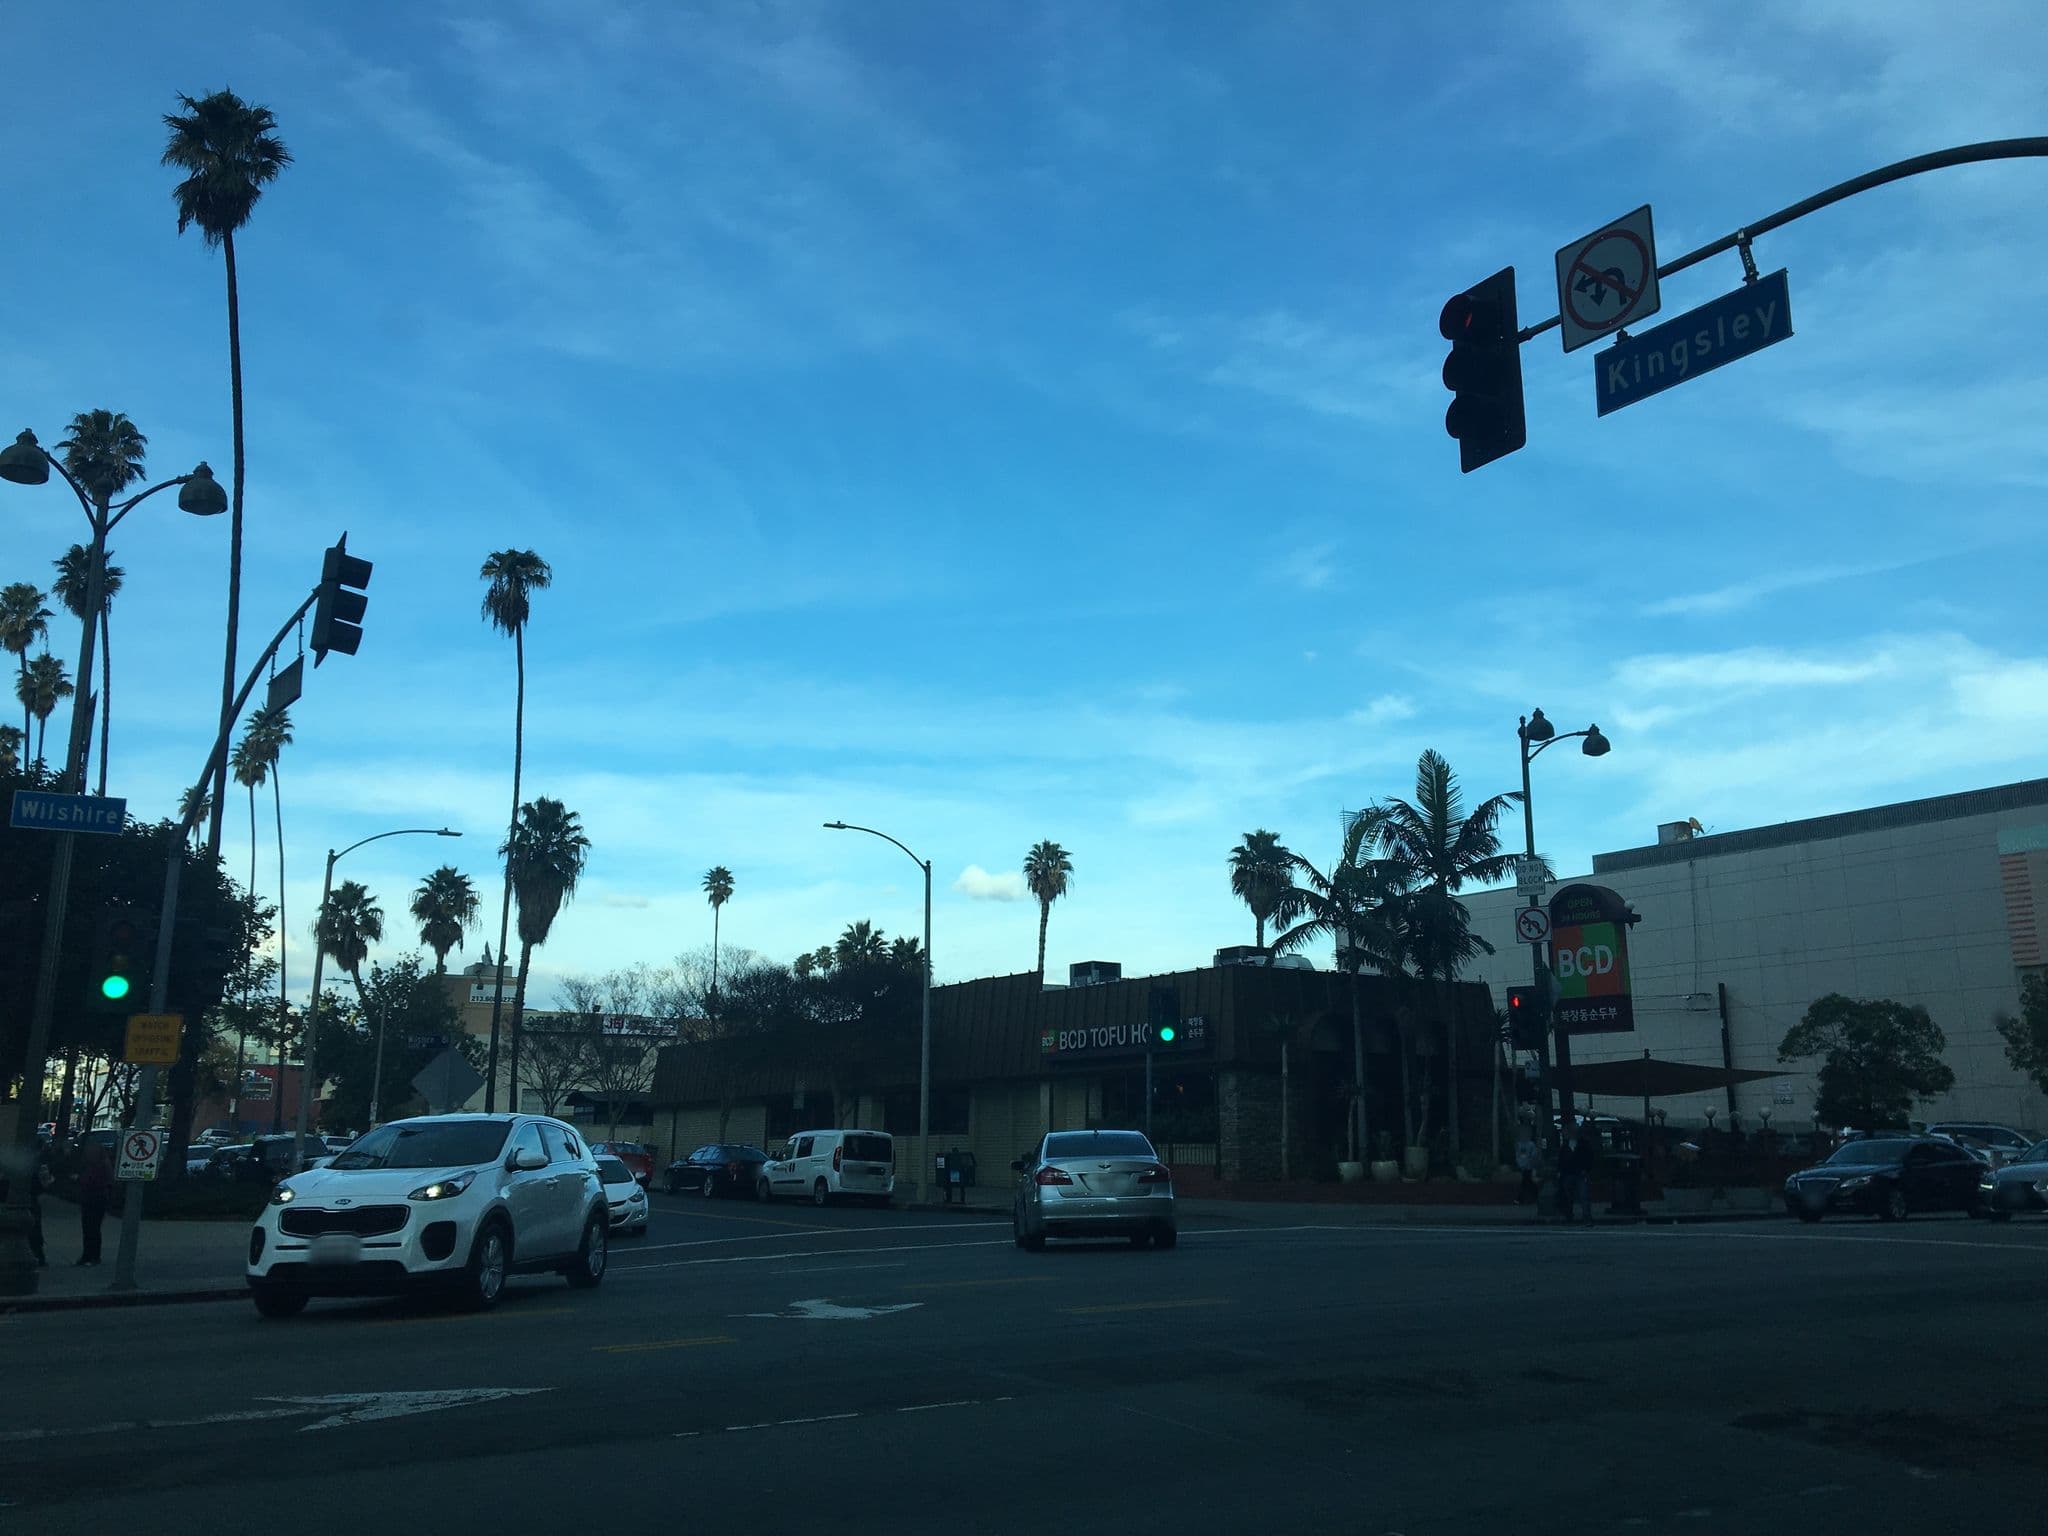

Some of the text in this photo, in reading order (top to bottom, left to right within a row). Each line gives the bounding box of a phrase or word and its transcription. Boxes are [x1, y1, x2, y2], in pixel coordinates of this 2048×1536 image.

[1608, 300, 1776, 394] Kingsley
[21, 799, 119, 824] Wilshire
[1518, 874, 1544, 886] BLOCK
[1558, 944, 1613, 978] BCD
[1058, 1029, 1087, 1050] BCD
[1090, 1025, 1127, 1048] TOFU
